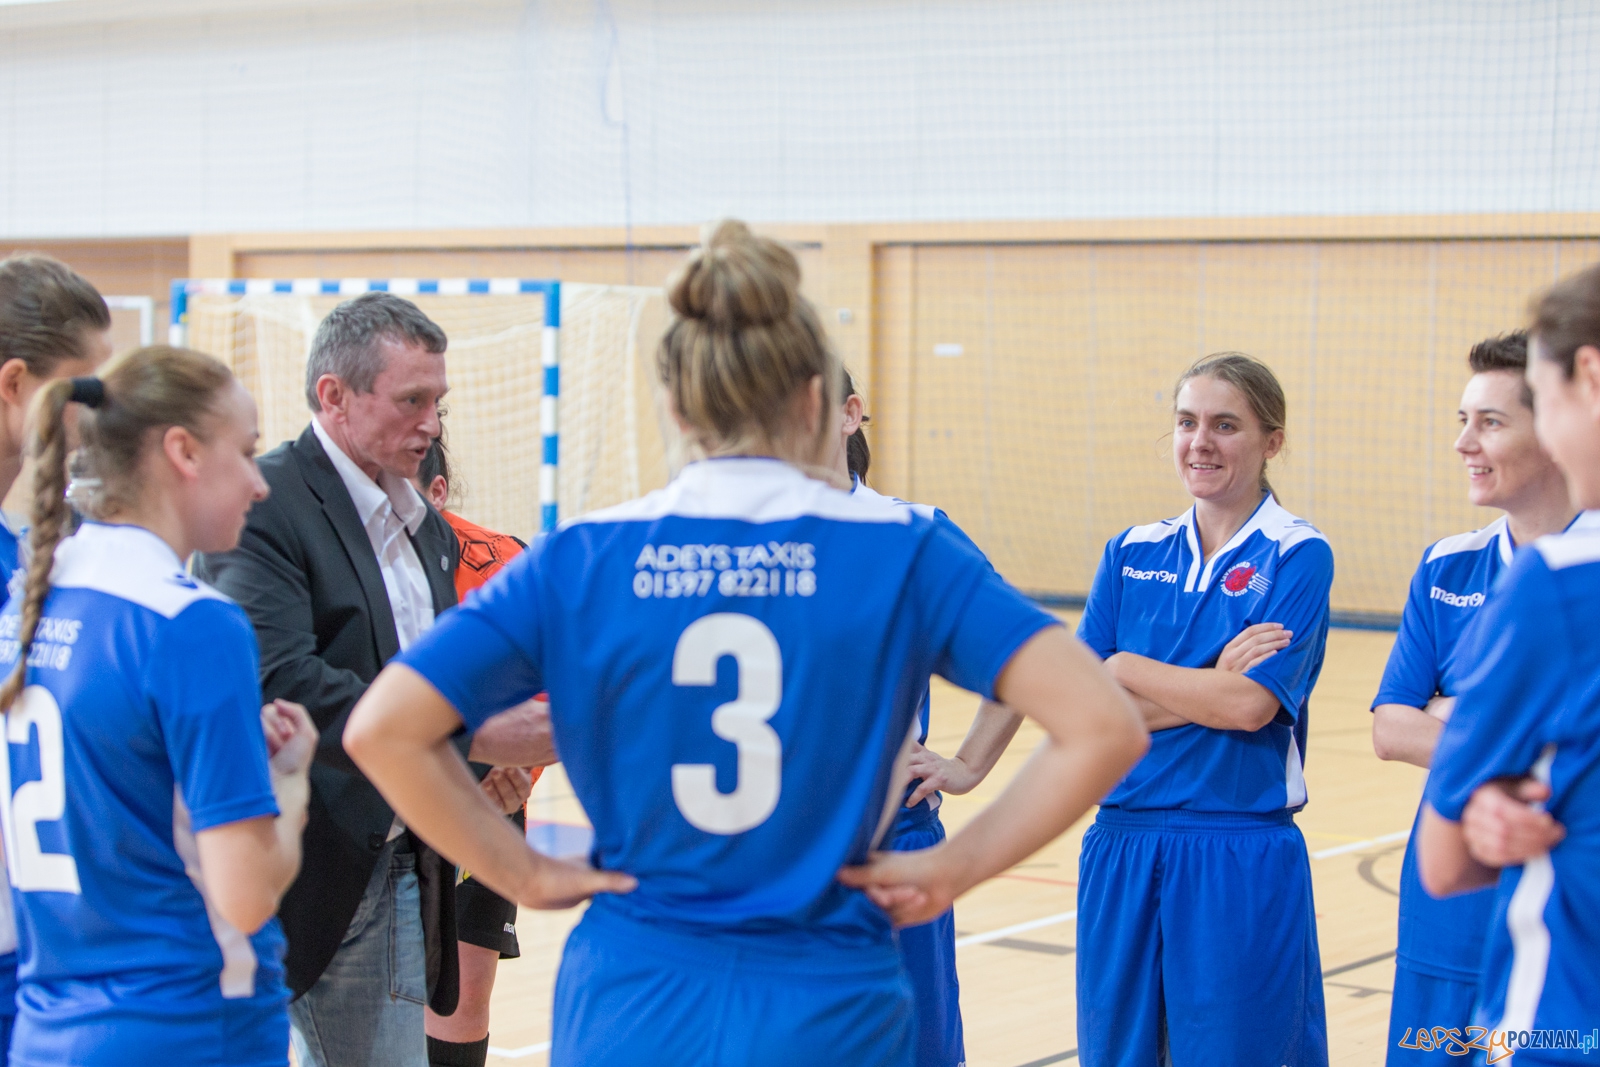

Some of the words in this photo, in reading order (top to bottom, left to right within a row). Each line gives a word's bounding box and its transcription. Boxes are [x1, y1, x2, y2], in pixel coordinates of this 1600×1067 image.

[635, 543, 732, 571] ADEYS
[732, 541, 816, 570] TAXIS
[633, 570, 716, 599] 01597
[718, 568, 817, 597] 822118
[26, 642, 72, 671] 22118
[671, 612, 783, 835] 3
